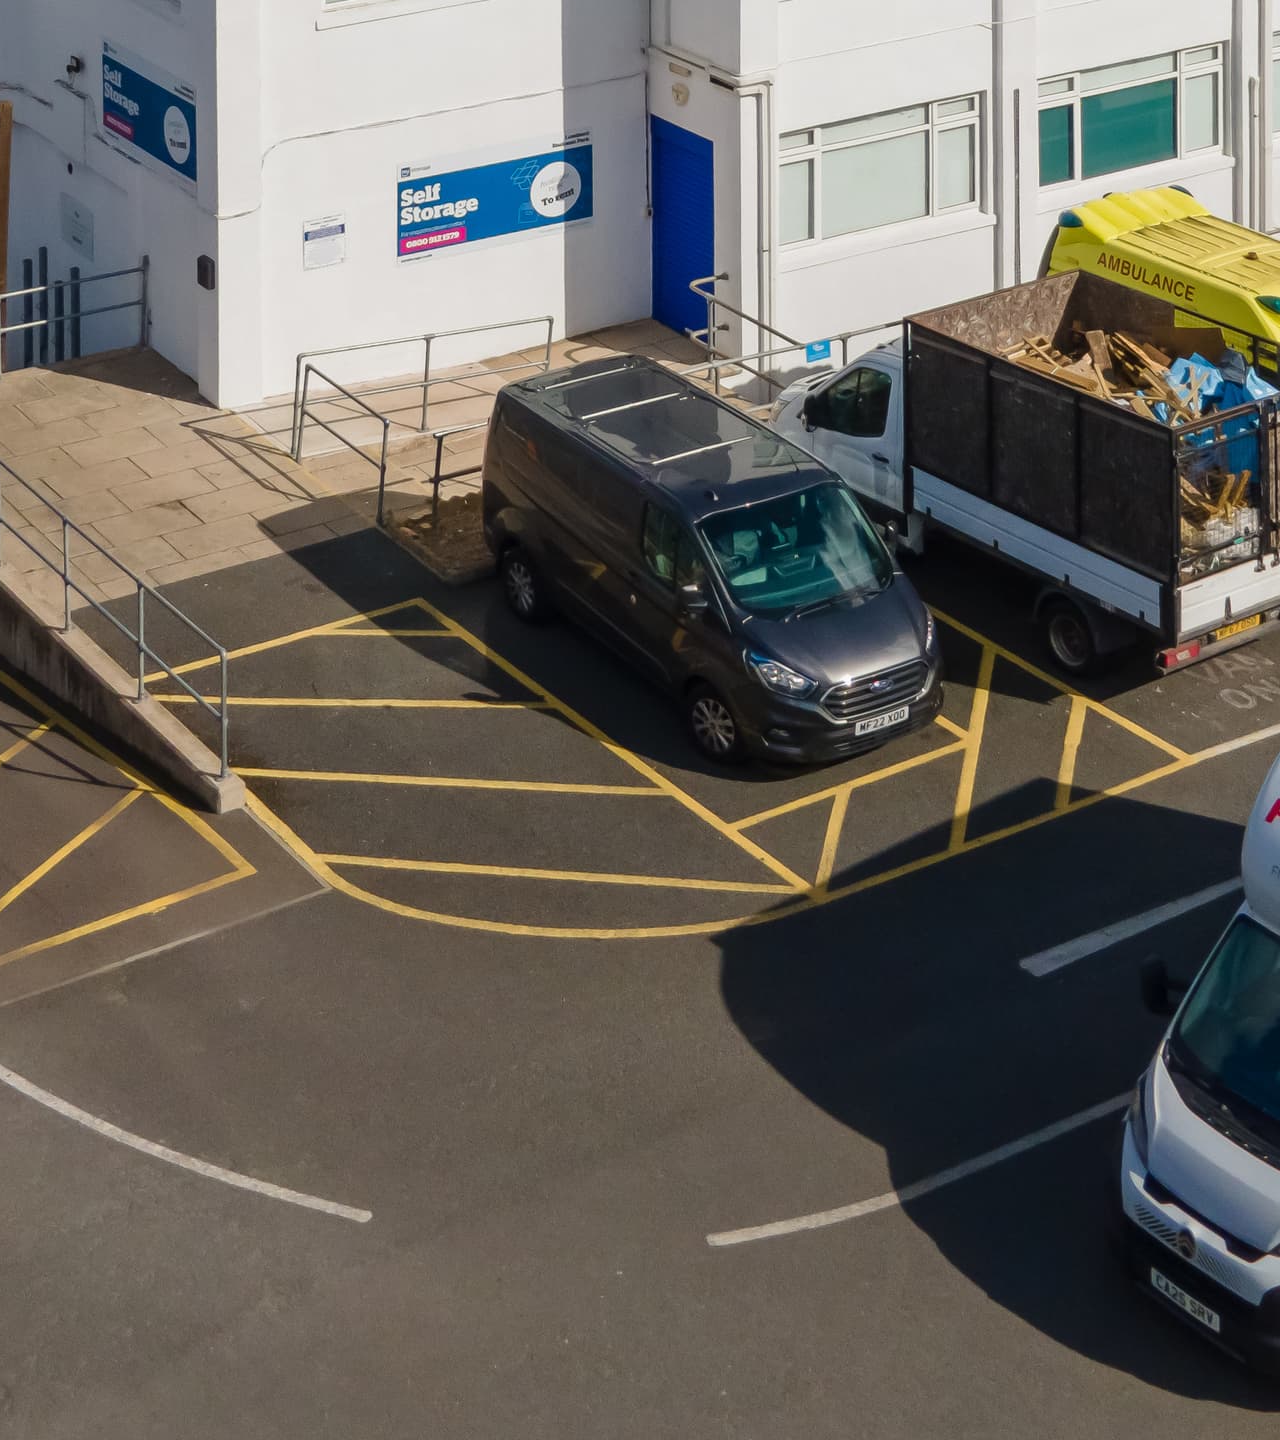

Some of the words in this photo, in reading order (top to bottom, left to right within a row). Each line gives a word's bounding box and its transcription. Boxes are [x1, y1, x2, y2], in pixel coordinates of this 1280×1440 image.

[103, 64, 122, 88] Self
[104, 82, 139, 116] Storage
[401, 183, 441, 207] Self
[541, 197, 554, 206] To
[555, 188, 575, 201] rent
[401, 198, 479, 226] Storage
[1097, 252, 1196, 302] AMBULANCE
